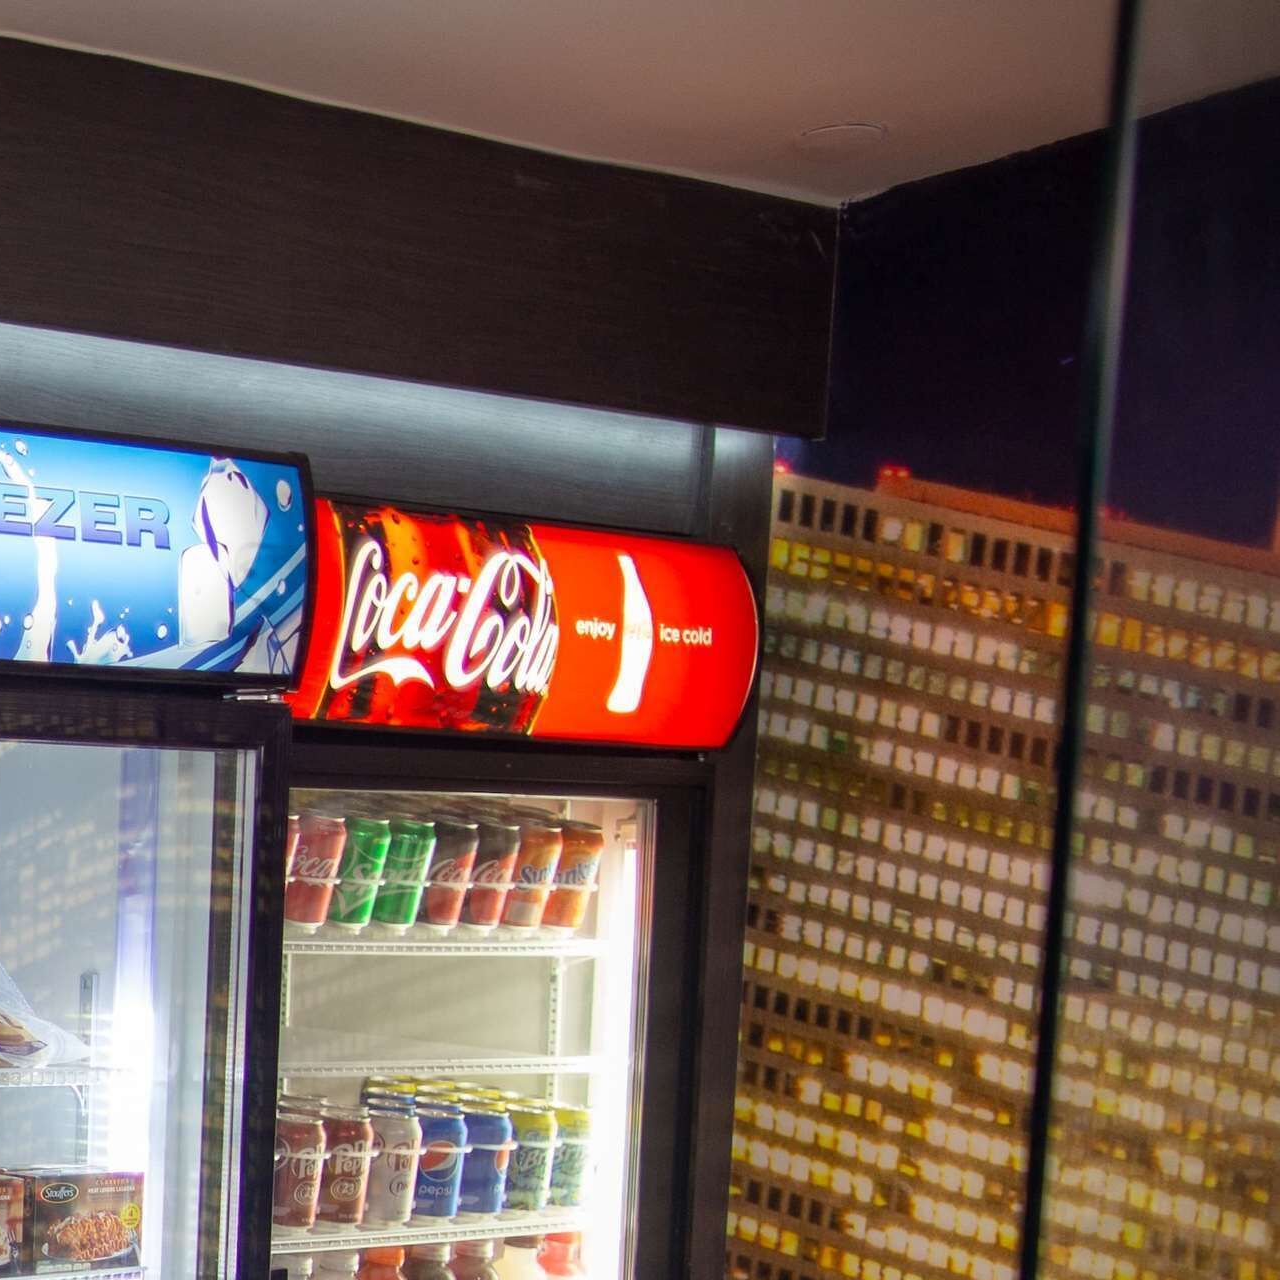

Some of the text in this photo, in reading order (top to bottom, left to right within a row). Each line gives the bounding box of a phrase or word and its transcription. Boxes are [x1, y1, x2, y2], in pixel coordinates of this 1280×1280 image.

[330, 541, 558, 695] Coca-Cola
[576, 618, 712, 645] enjoy ice cold
